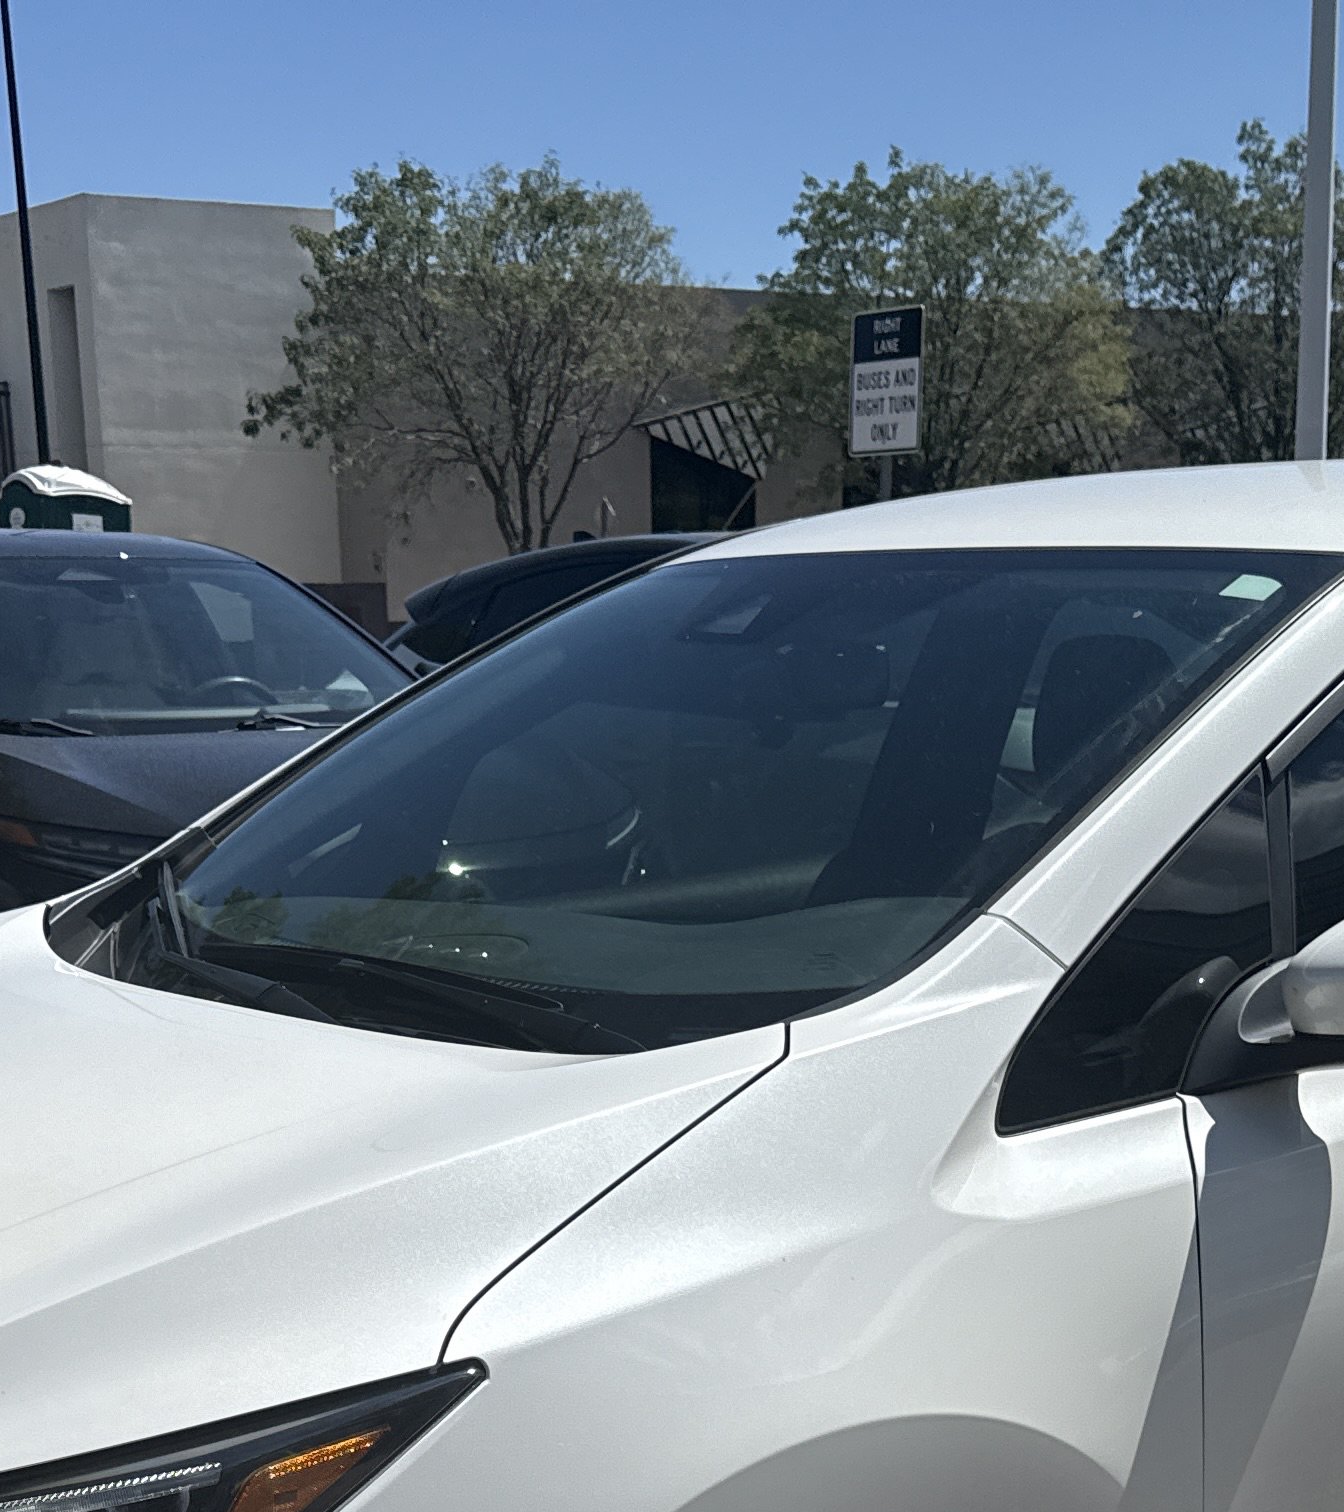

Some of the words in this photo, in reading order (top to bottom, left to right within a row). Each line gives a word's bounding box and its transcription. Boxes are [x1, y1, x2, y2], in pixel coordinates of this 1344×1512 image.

[873, 317, 902, 334] RIGHT
[873, 338, 900, 355] LANE
[857, 370, 890, 391] BUSES
[893, 368, 916, 387] AND
[856, 397, 885, 416] RIGHT
[888, 395, 916, 414] TURN
[870, 423, 899, 443] ONLY
